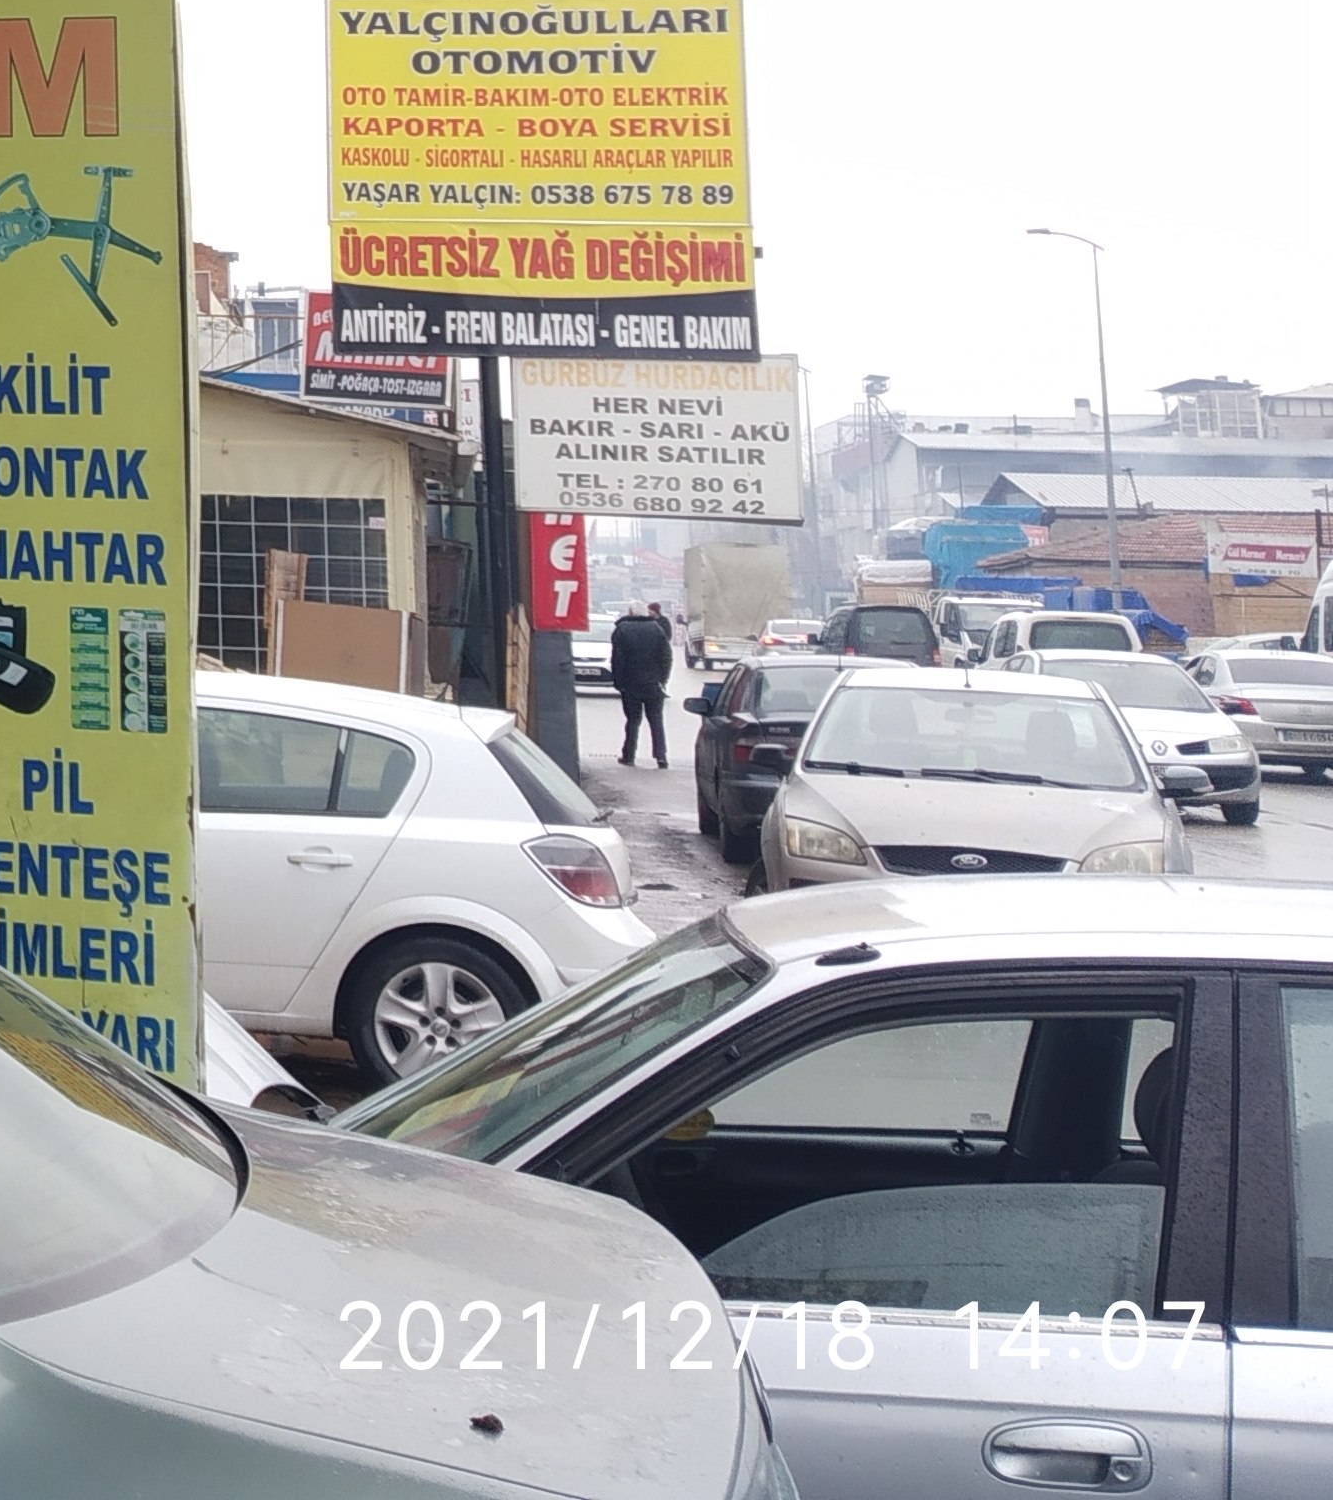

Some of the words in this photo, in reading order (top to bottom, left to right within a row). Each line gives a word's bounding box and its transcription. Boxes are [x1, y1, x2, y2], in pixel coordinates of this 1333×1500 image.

[339, 4, 728, 42] YALÇINOĞULLARI
[411, 42, 657, 76] OTOMOTİV
[342, 87, 387, 107] OTO
[613, 82, 728, 107] ELEKTRİK
[342, 117, 484, 138] KAPORTA
[517, 117, 597, 138] BOYA
[609, 113, 731, 138] SERVİSİ
[341, 148, 410, 168] KASKOLU
[425, 143, 505, 168] SİGORTALI
[520, 148, 588, 169] HASARLI
[592, 149, 666, 174] ARAÇLAR
[672, 149, 733, 169] YAPILIR
[342, 182, 420, 207] YAŞAR
[431, 184, 521, 210] YALÇIN:
[532, 185, 595, 205] 0538
[604, 185, 652, 205] 675
[661, 185, 694, 205] 78
[702, 185, 734, 205] 89
[338, 227, 500, 278] ÜCRETSİZ
[508, 230, 575, 281] YAĞ
[585, 230, 746, 287] DEĞİŞİMİ
[340, 303, 427, 344] ANTİFRİZ
[445, 310, 497, 346] FREN
[502, 312, 596, 349] BALATASI
[613, 315, 681, 349] GENEL
[684, 315, 752, 350] BAKIM
[635, 362, 793, 392] HURDACILIK
[593, 397, 649, 414] HER
[659, 396, 723, 416] NEVİ
[530, 419, 615, 437] BAKIR
[640, 422, 703, 439] SARI
[731, 422, 790, 442] AKÜ
[555, 443, 648, 462] ALINIR
[657, 446, 765, 465] SATILIR
[557, 474, 608, 489] TEL
[633, 474, 681, 490] 270
[691, 478, 723, 493] 80
[733, 479, 763, 494] 61
[559, 492, 623, 508] 0536
[633, 497, 681, 512] 680
[691, 500, 723, 514] 92
[732, 500, 765, 514] 42
[22, 748, 94, 815] PİL
